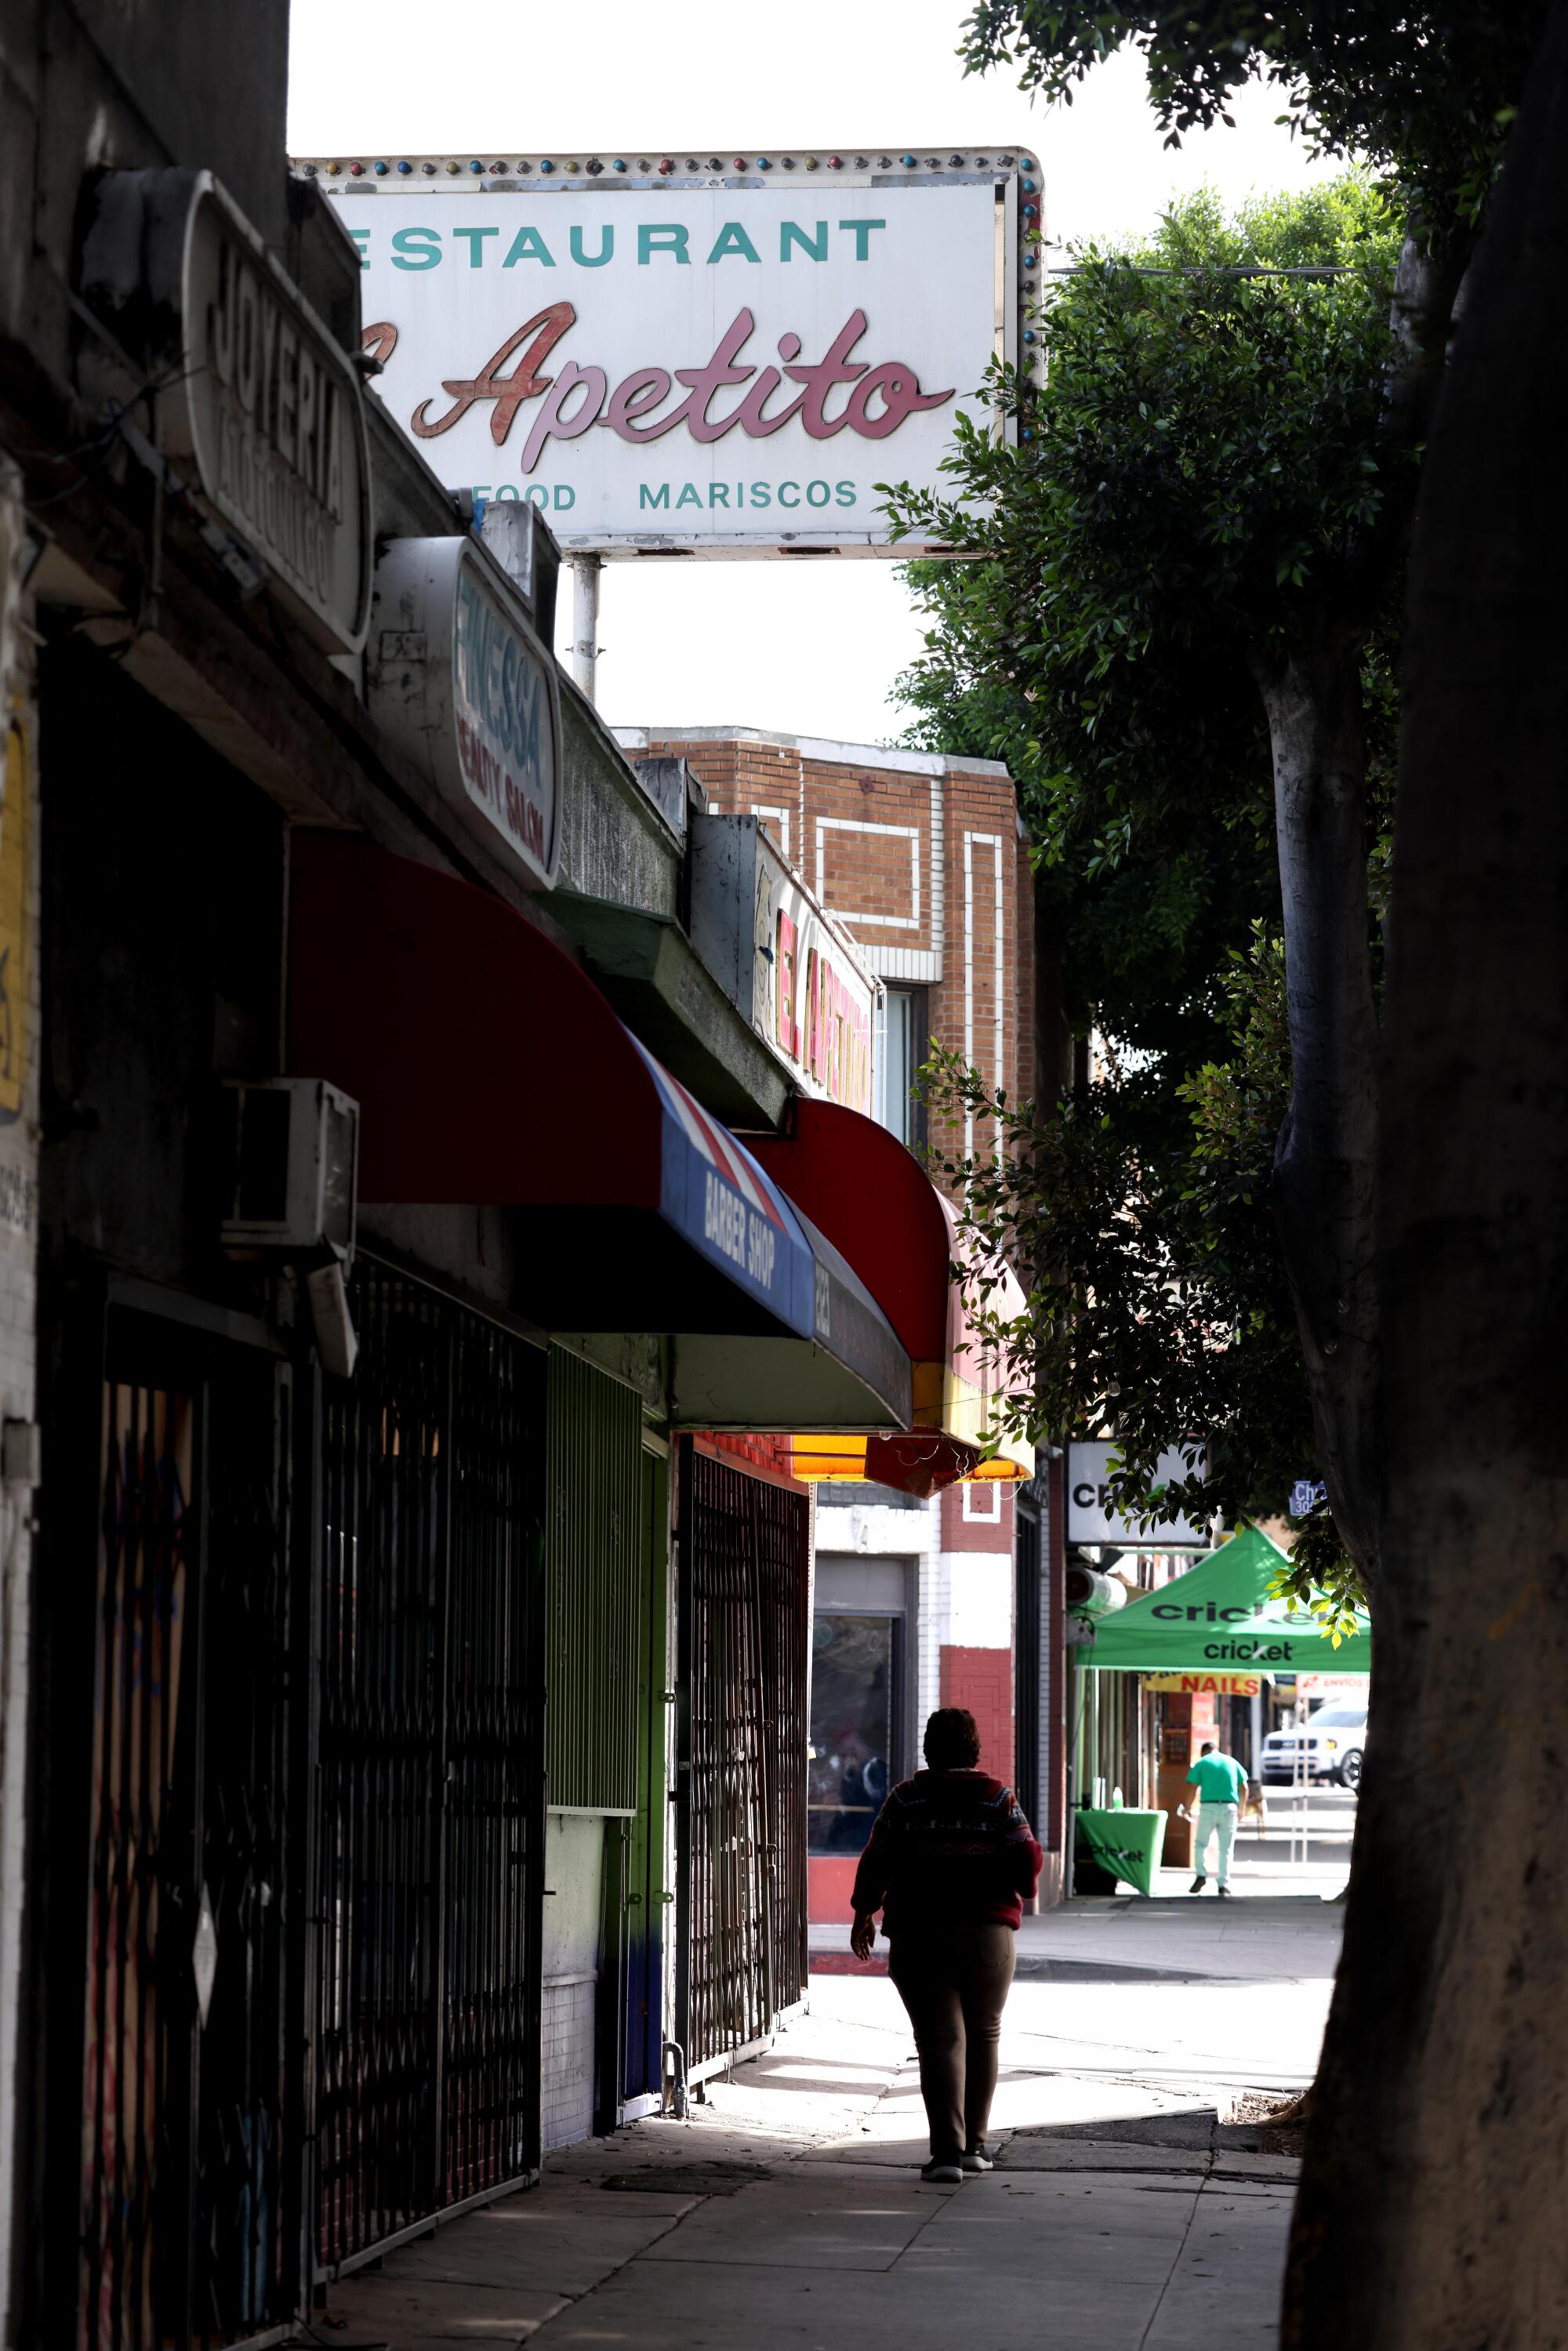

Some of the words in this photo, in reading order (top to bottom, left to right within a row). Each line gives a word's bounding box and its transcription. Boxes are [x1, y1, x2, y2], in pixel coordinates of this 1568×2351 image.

[207, 237, 343, 524] JOYERIA
[411, 301, 955, 473] Apetito
[639, 481, 858, 510] MARISCOS
[505, 775, 544, 864] SALON
[775, 908, 802, 1064] EL
[705, 1170, 746, 1268] BARBER
[748, 1212, 775, 1290] SHOP
[1181, 1675, 1258, 1695] NAILS
[1204, 1640, 1294, 1660] cricket
